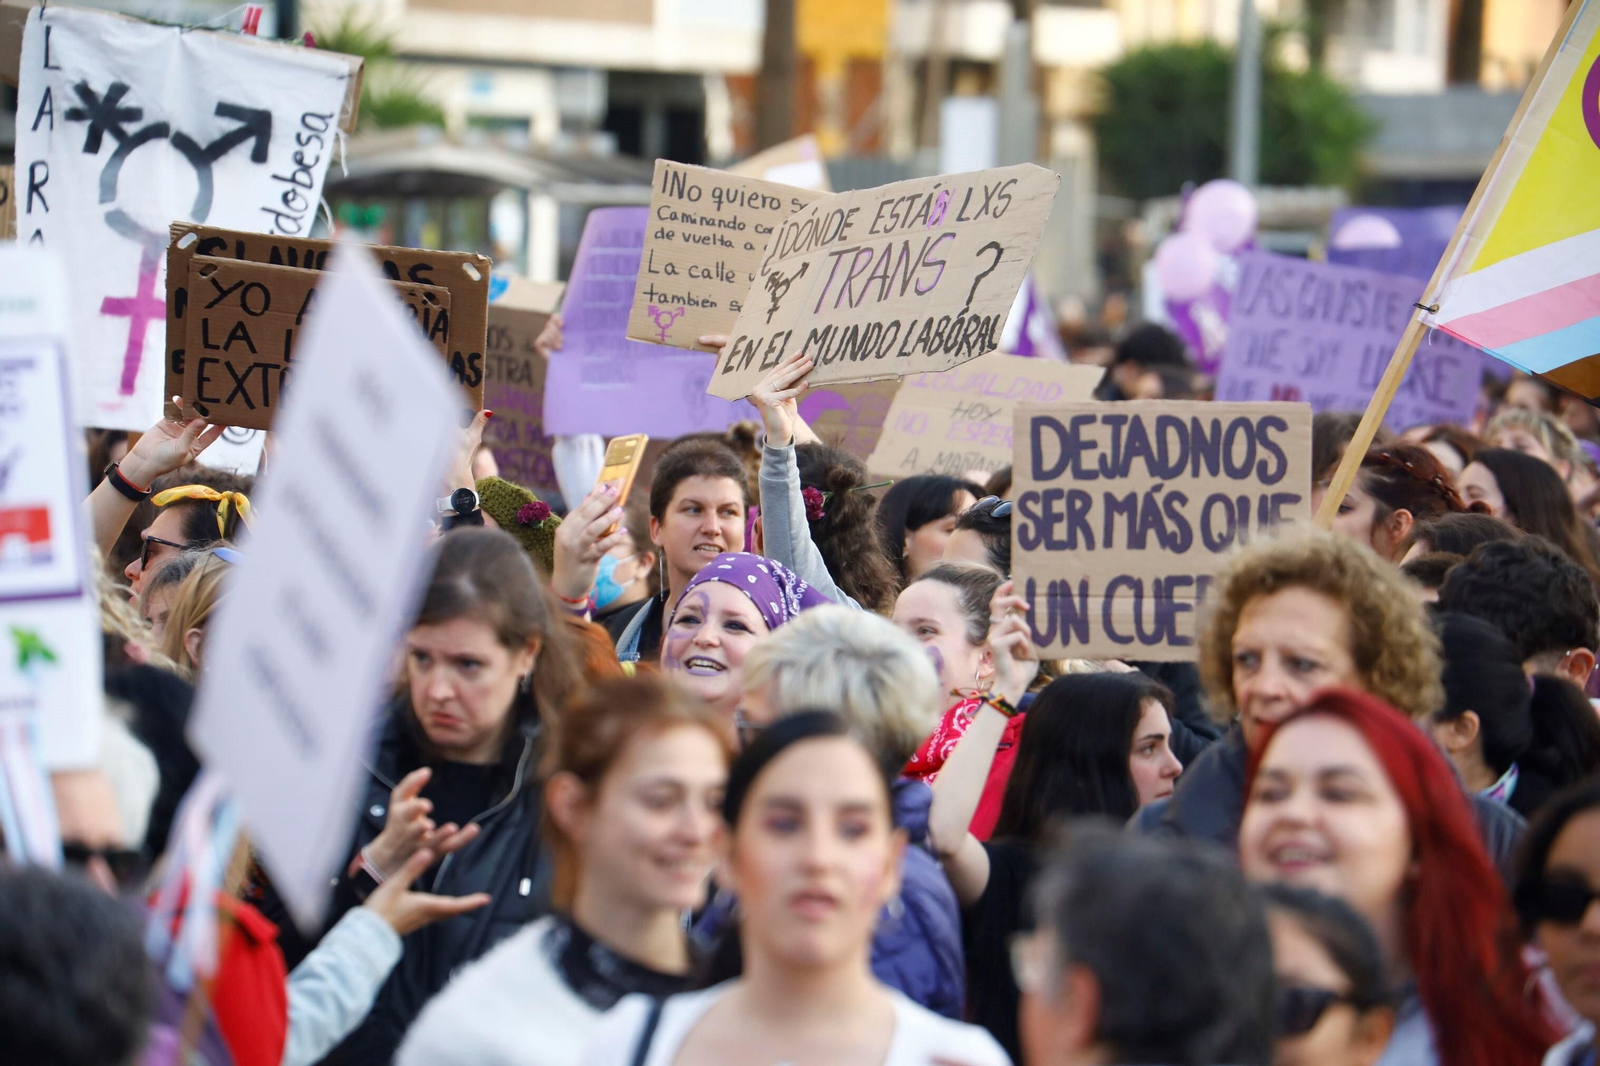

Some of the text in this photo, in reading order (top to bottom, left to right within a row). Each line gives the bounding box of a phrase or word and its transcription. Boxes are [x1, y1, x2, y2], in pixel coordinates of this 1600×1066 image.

[259, 111, 335, 235] dobesa
[656, 204, 746, 232] Caminando
[711, 184, 781, 212] quiero
[653, 227, 675, 241] de
[681, 232, 735, 250] vuelta
[743, 241, 756, 251] a
[760, 206, 861, 277] ¿DÓNDE
[955, 178, 1019, 223] LXS
[648, 248, 680, 276] La
[687, 260, 736, 284] calle
[813, 231, 957, 315] TRANS
[204, 276, 272, 318] YO
[642, 282, 718, 309] también
[201, 317, 258, 355] LA
[721, 335, 762, 376] EN
[801, 318, 902, 368] MUNDO
[950, 399, 1003, 422] HOY
[899, 446, 920, 470] A
[1030, 413, 1289, 486] DEJADNOS
[1016, 482, 1303, 554] SER MÁS QUE
[1024, 574, 1216, 648] UN CUE
